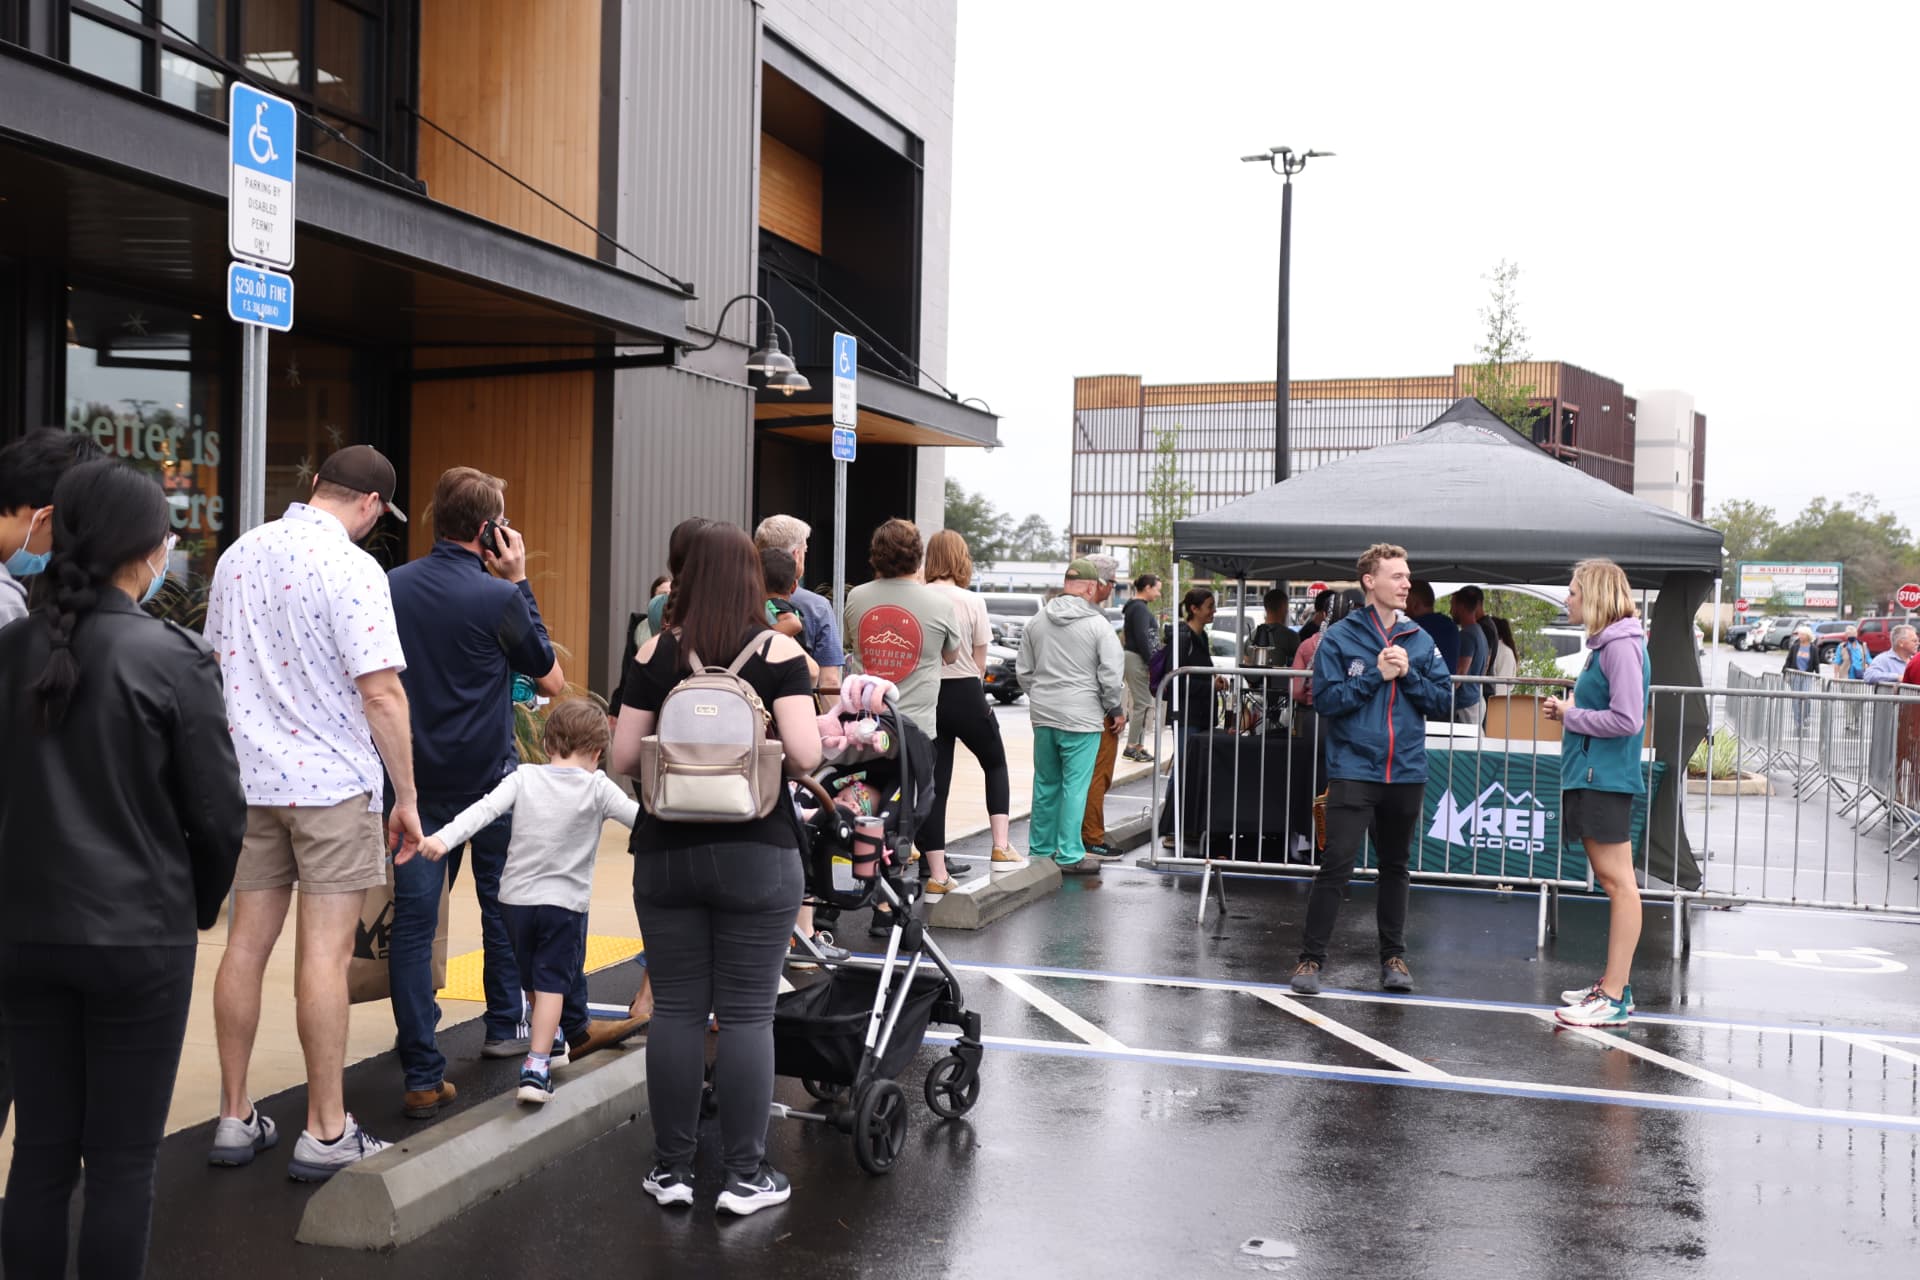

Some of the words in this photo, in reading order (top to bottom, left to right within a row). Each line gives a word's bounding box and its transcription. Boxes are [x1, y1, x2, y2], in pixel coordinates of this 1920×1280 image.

[244, 176, 272, 195] PARKING
[273, 185, 281, 197] BY
[247, 197, 277, 216] DISABLED
[251, 217, 274, 233] PERMIT
[235, 274, 267, 298] $250.00
[270, 284, 288, 303] FINE
[191, 413, 221, 467] is
[167, 492, 224, 531] ere
[864, 648, 912, 659] SOUTHERN
[871, 658, 902, 668] MARSH
[1470, 807, 1544, 839] REI
